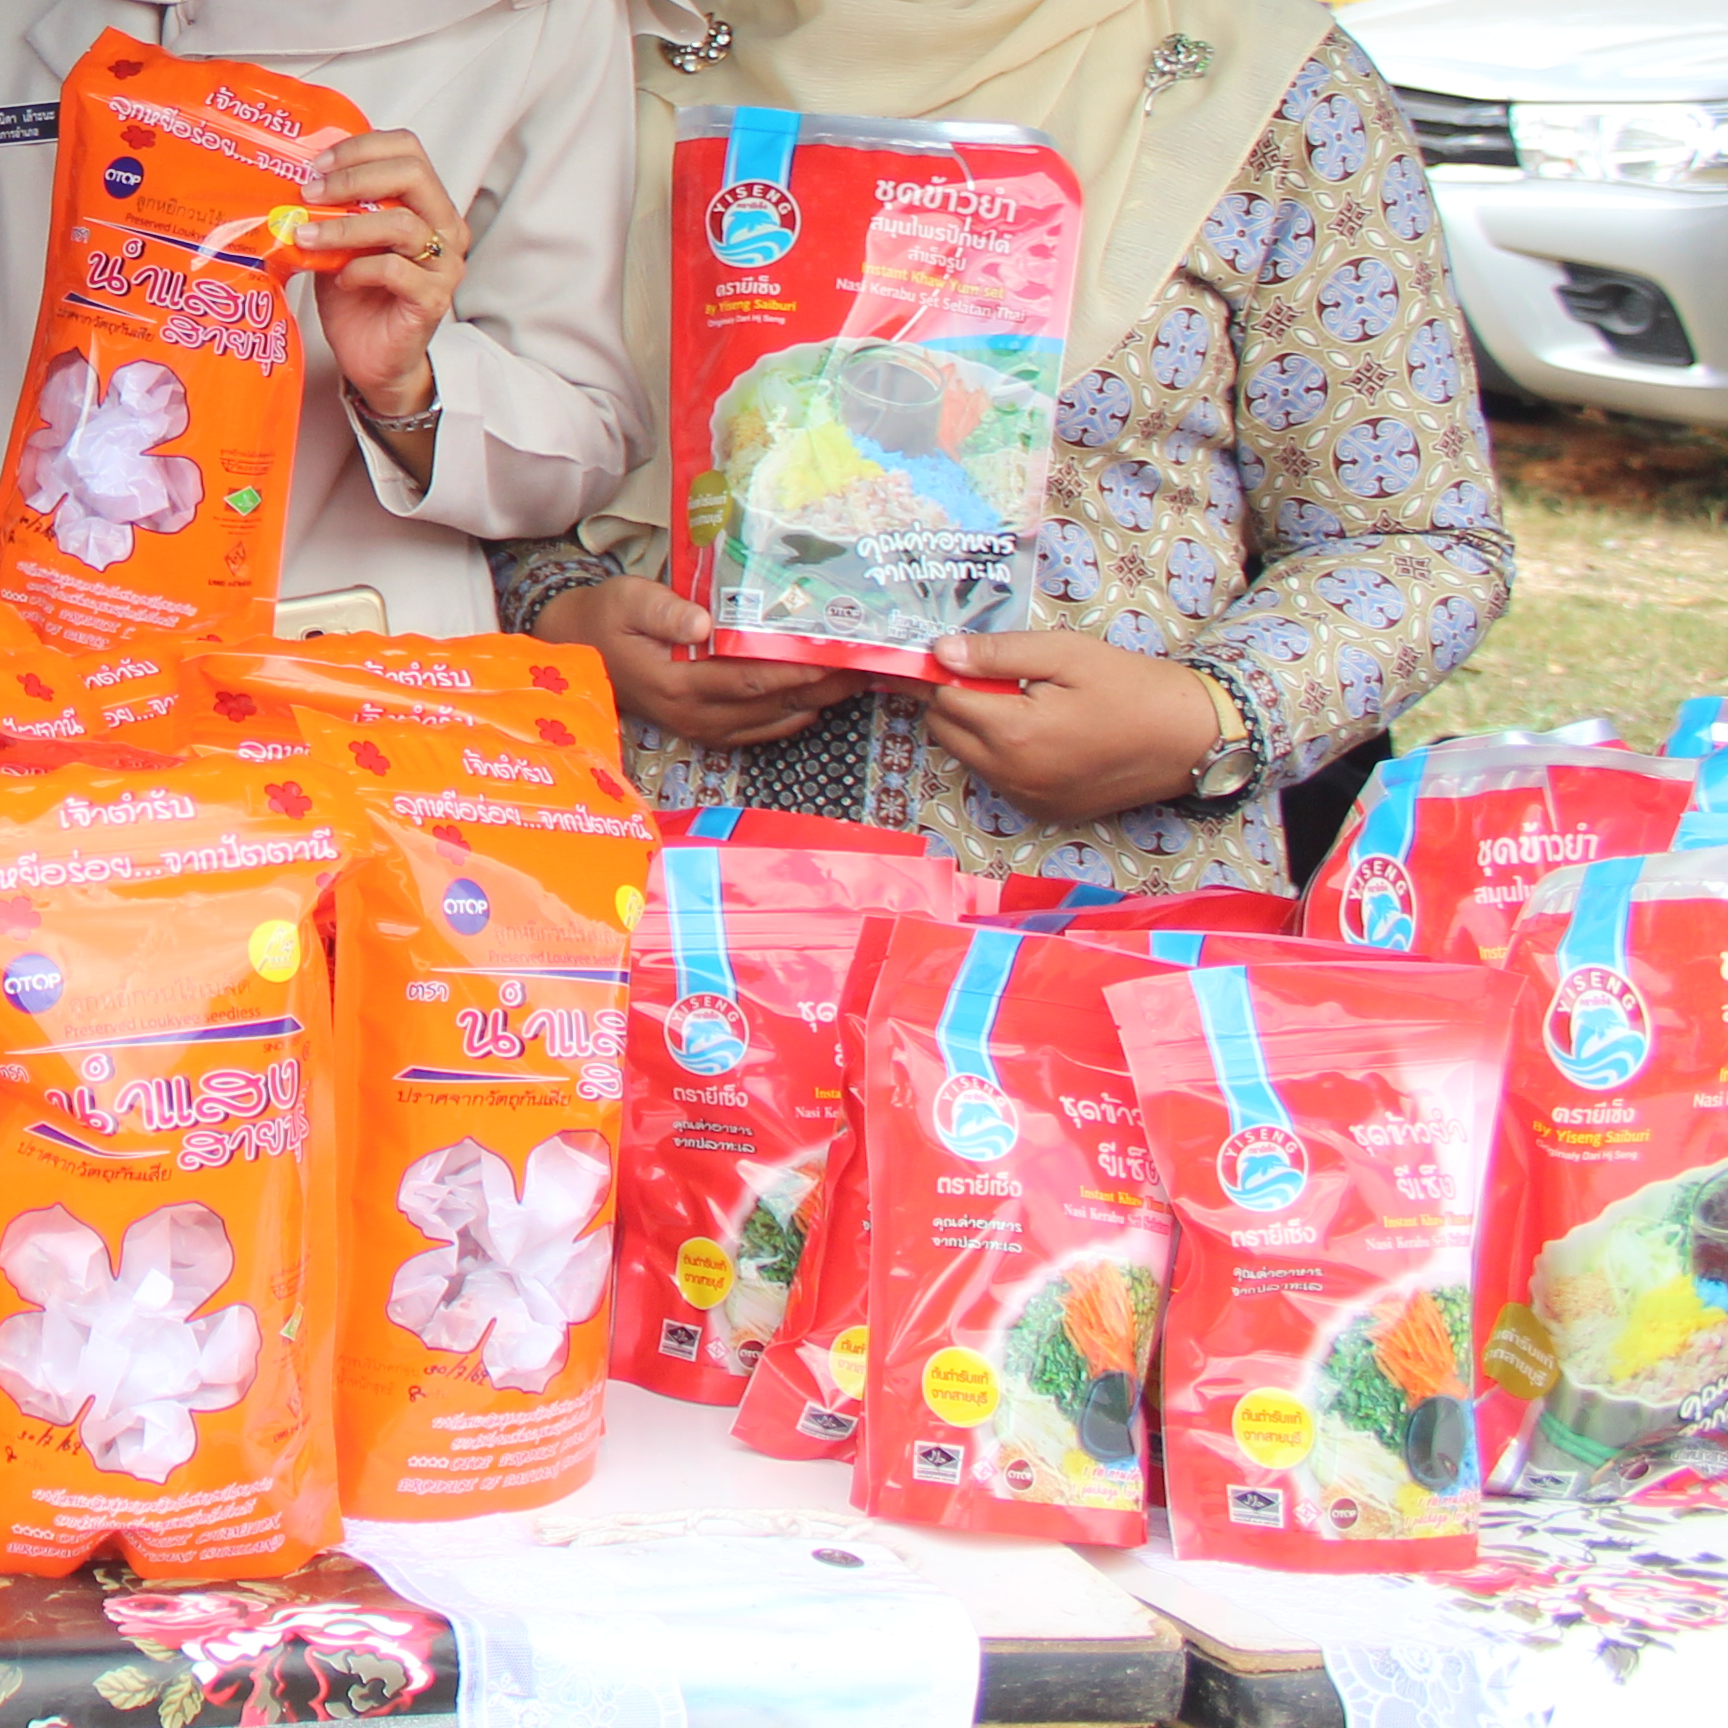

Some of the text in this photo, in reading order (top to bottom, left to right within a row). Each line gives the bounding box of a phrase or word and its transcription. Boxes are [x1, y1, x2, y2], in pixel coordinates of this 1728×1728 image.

[204, 84, 301, 141] เจ้าตำรับ
[105, 168, 142, 186] OTOP
[712, 184, 792, 216] YISENG
[874, 176, 1018, 223] ชุดข้าวยำ
[86, 239, 274, 328] นำแสง
[715, 271, 782, 298] ตรายีเซ็ง
[836, 277, 917, 304] Nasi Kerabu
[160, 316, 288, 377] สายบุรี
[463, 749, 556, 787] เจ้าตำรับ
[58, 789, 196, 831] เจ้าตำรับ
[1477, 821, 1599, 878] ชุดข้าวยำ
[1348, 860, 1406, 902] YISENG
[444, 898, 488, 915] OTOP
[3, 971, 61, 996] OTOP
[406, 981, 449, 1002] ตรา
[1557, 971, 1638, 1013] YISENG
[63, 1004, 262, 1039] Preserved Loukyee seedless
[670, 997, 740, 1022] YISENG
[45, 1053, 299, 1137] นำแสง
[673, 1084, 749, 1108] ตรายีเซ็ง
[941, 1075, 1008, 1108] YISENG
[1693, 1093, 1724, 1108] Nasi
[794, 1106, 821, 1119] Nasi
[1551, 1098, 1635, 1124] ตรายีเซ็ง
[1224, 1128, 1298, 1159] YISENG
[1533, 1121, 1651, 1147] By Yiseng Saiburi
[936, 1172, 1023, 1198] ตรายีเซ็ง
[1079, 1185, 1115, 1203] Instant
[1063, 1202, 1086, 1220] Nasi
[1230, 1218, 1317, 1249] ตรายีเซ็ง
[1365, 1237, 1393, 1251] Nasi
